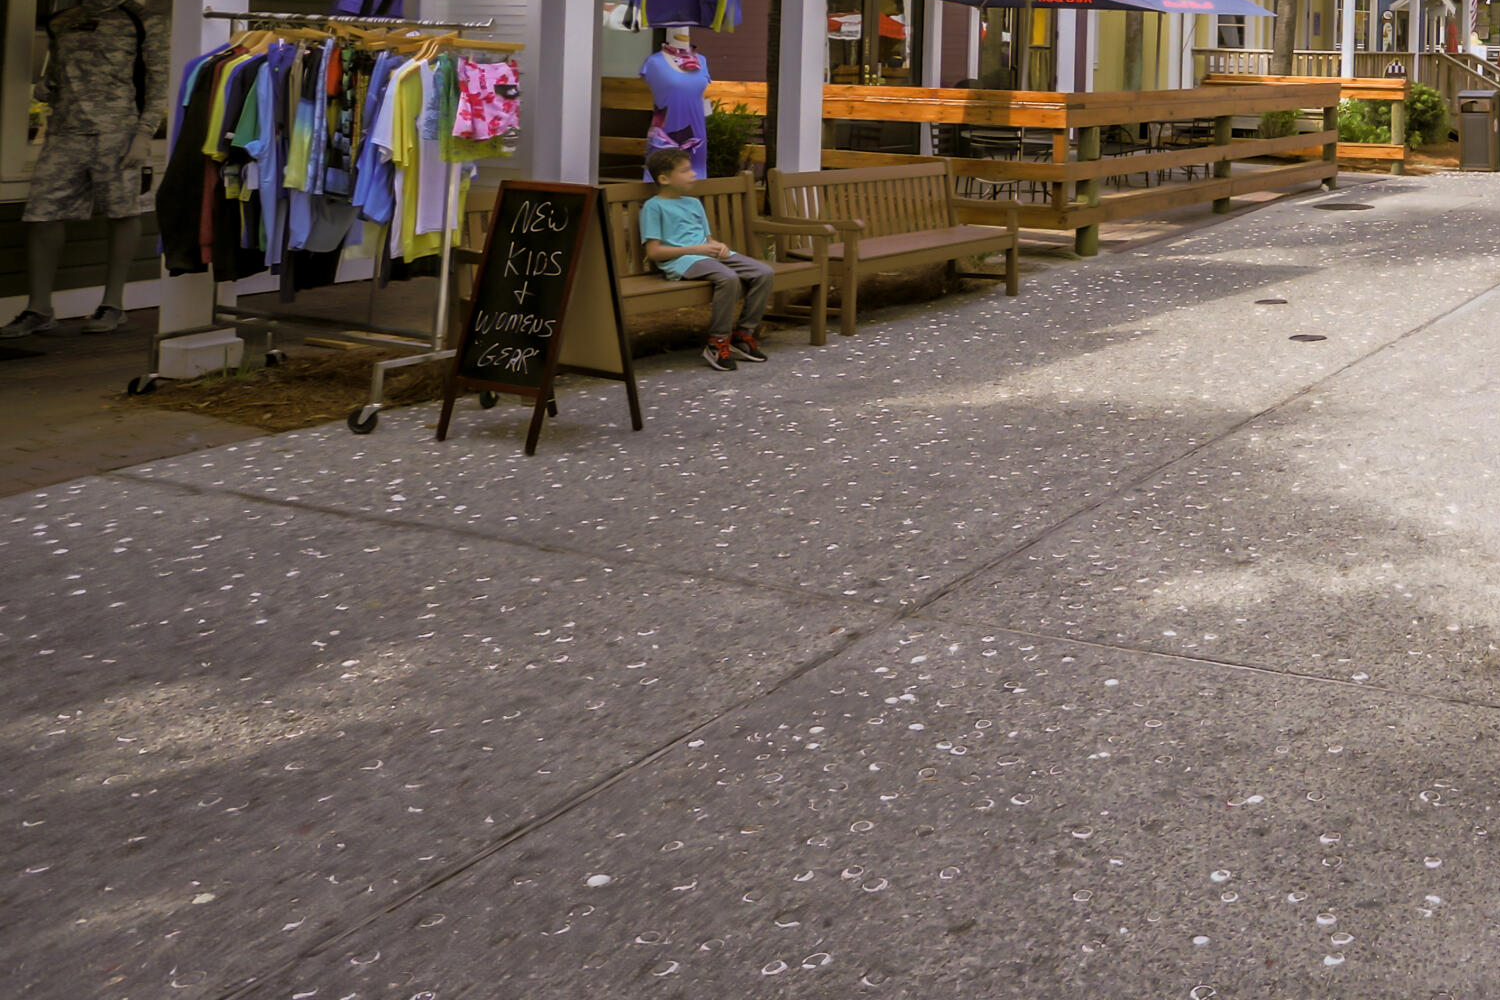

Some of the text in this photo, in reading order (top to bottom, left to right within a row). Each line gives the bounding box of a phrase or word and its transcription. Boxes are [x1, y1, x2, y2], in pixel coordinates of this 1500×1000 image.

[510, 200, 569, 234] NEW
[503, 241, 563, 278] KIDS
[475, 310, 557, 338] WOMENS
